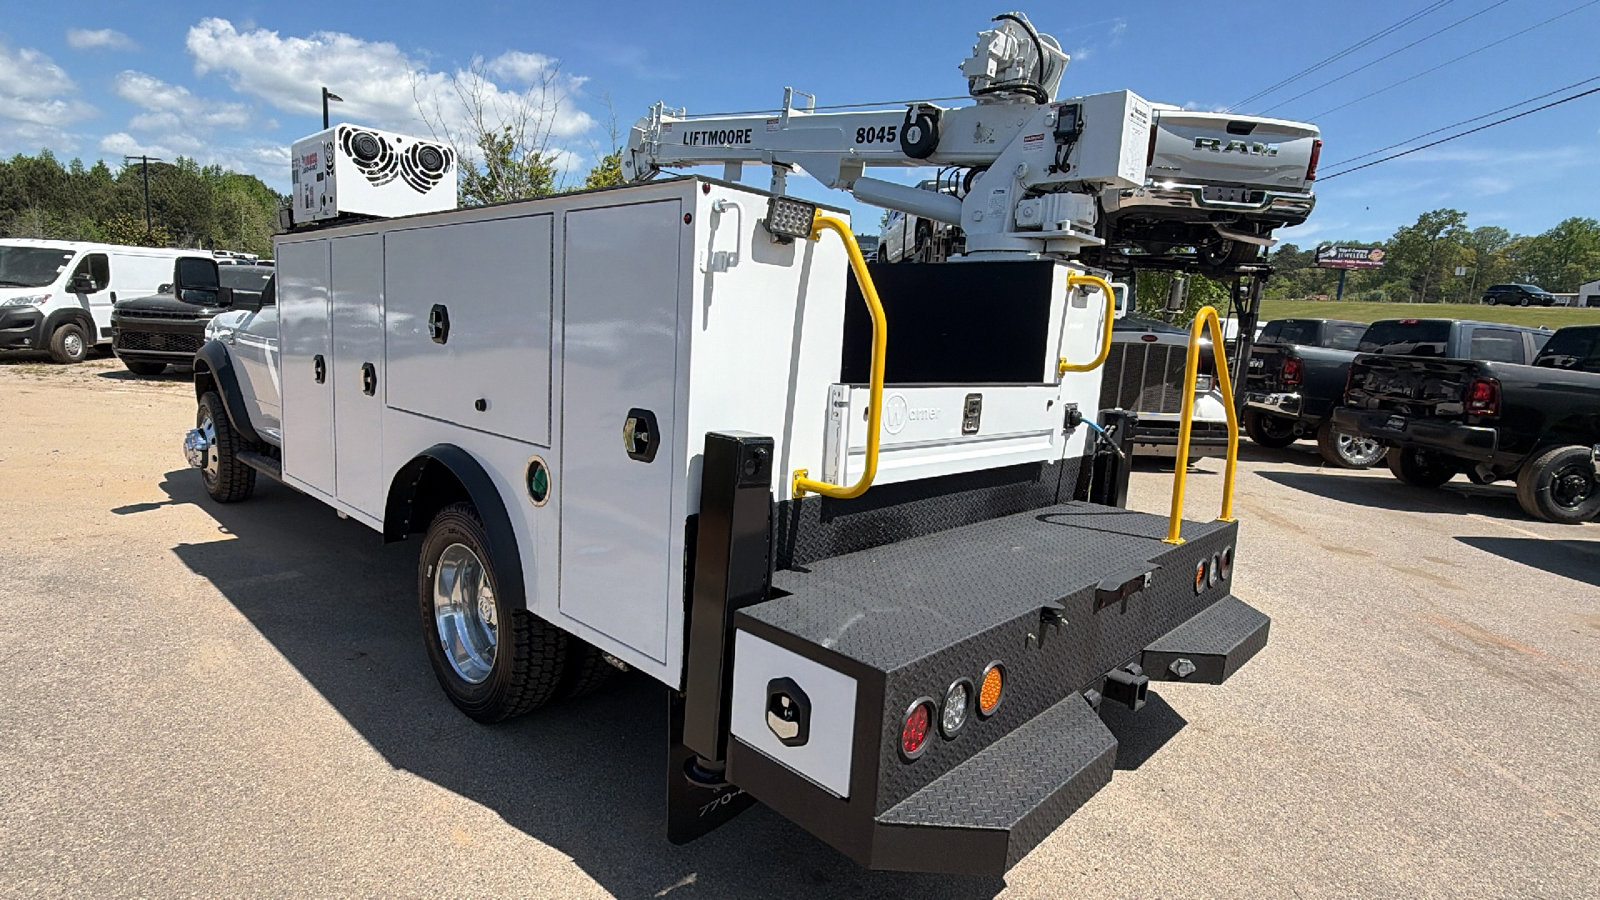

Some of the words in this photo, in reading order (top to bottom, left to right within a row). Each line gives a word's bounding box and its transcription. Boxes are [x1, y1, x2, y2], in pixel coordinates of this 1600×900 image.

[683, 129, 752, 145] LIFTMOORE
[856, 126, 897, 144] 8045
[1193, 136, 1279, 157] RAM
